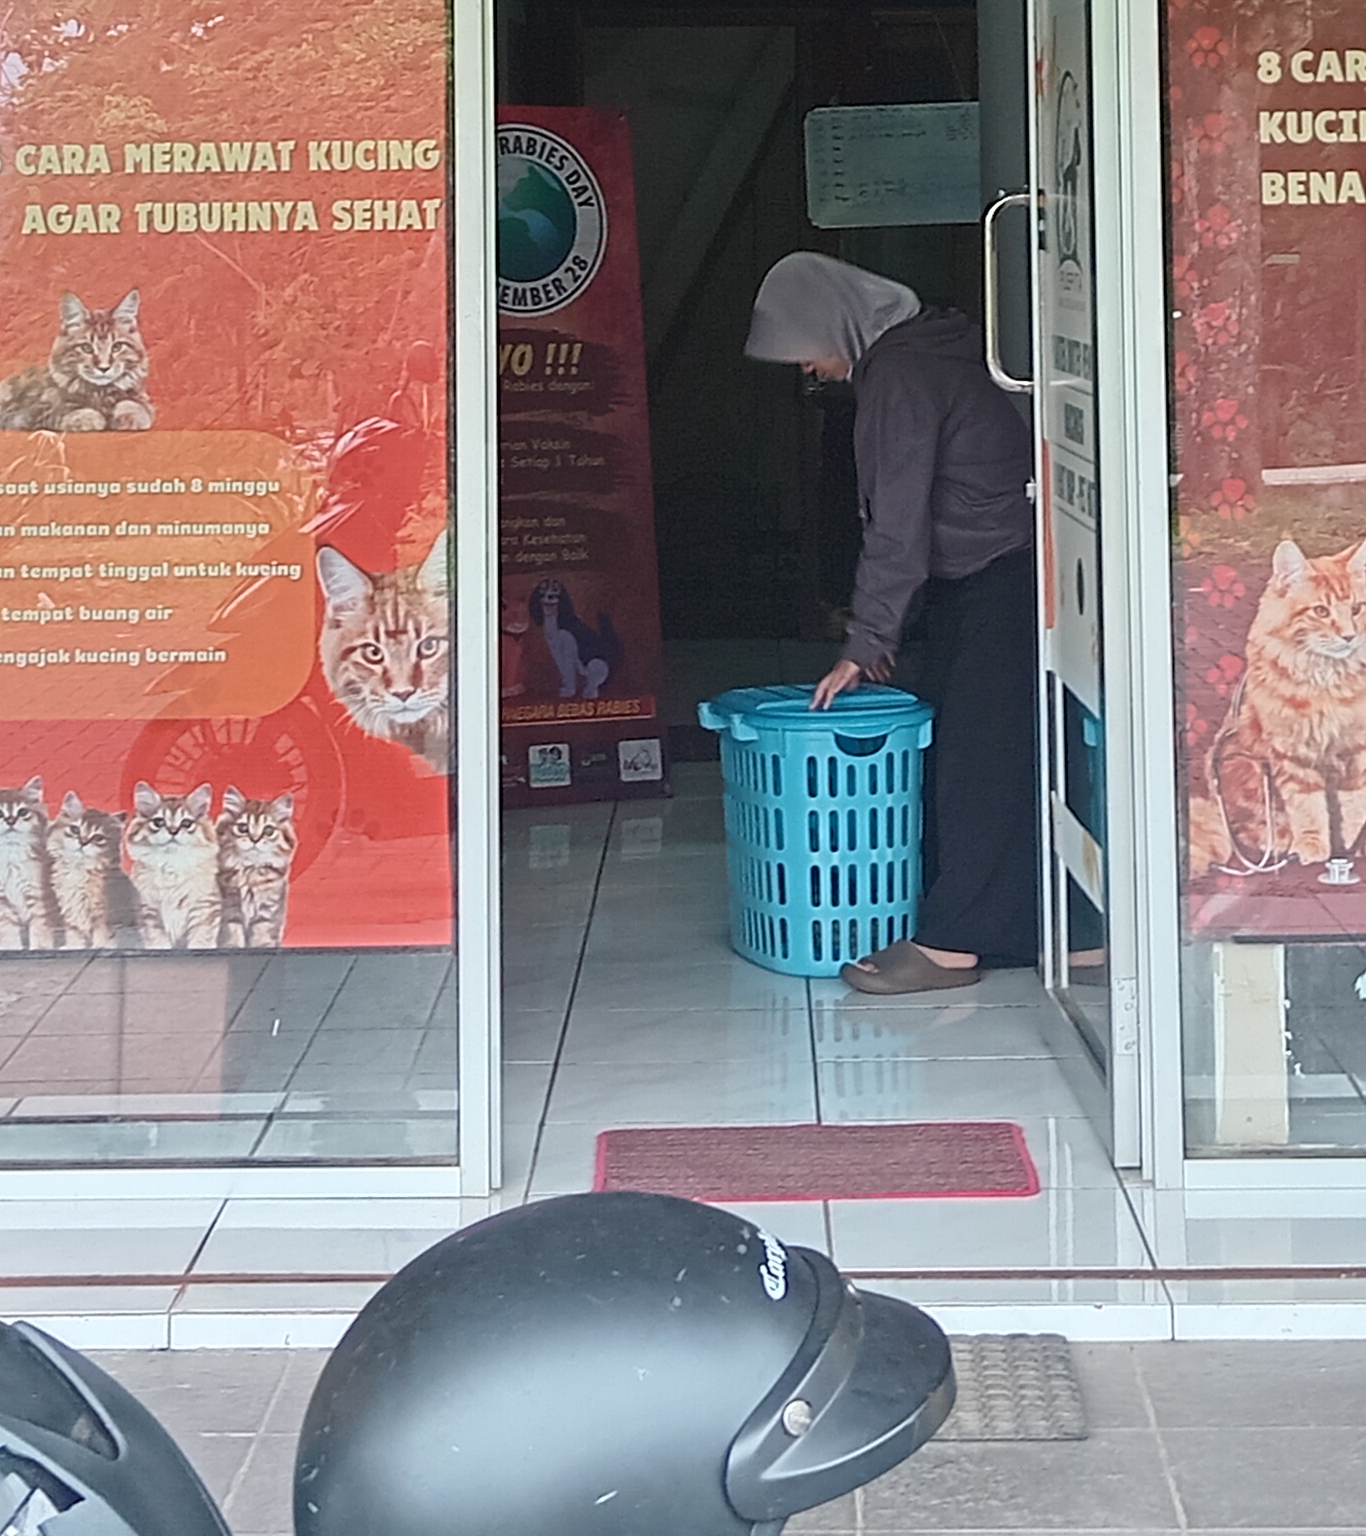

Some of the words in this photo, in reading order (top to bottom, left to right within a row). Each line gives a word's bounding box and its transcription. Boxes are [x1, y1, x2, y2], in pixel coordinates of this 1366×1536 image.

[1257, 51, 1282, 84] 8
[15, 143, 111, 175] CARA
[124, 140, 295, 174] MERAWAT
[308, 139, 440, 172] KUCING
[499, 135, 569, 172] RABIES
[565, 170, 595, 208] DAY
[21, 203, 121, 234] AGAR
[135, 201, 319, 233] TUBUHNYA
[332, 198, 442, 231] SEHAT
[499, 277, 568, 307] EMBER
[565, 255, 588, 282] 28
[44, 480, 121, 497] usianya
[126, 478, 185, 494] sudah
[190, 478, 203, 494] 8
[208, 478, 280, 496] minggu
[20, 522, 110, 537] makanan
[115, 521, 151, 536] dan
[156, 520, 270, 538] minumanya
[21, 563, 93, 582] tempat
[99, 562, 168, 581] tinggal
[173, 562, 231, 577] untuk
[236, 561, 302, 580] kucing
[1, 606, 74, 625] tempat
[79, 605, 140, 624] buang
[145, 604, 173, 621] air
[75, 648, 140, 667] kucing
[145, 647, 226, 663] bermain
